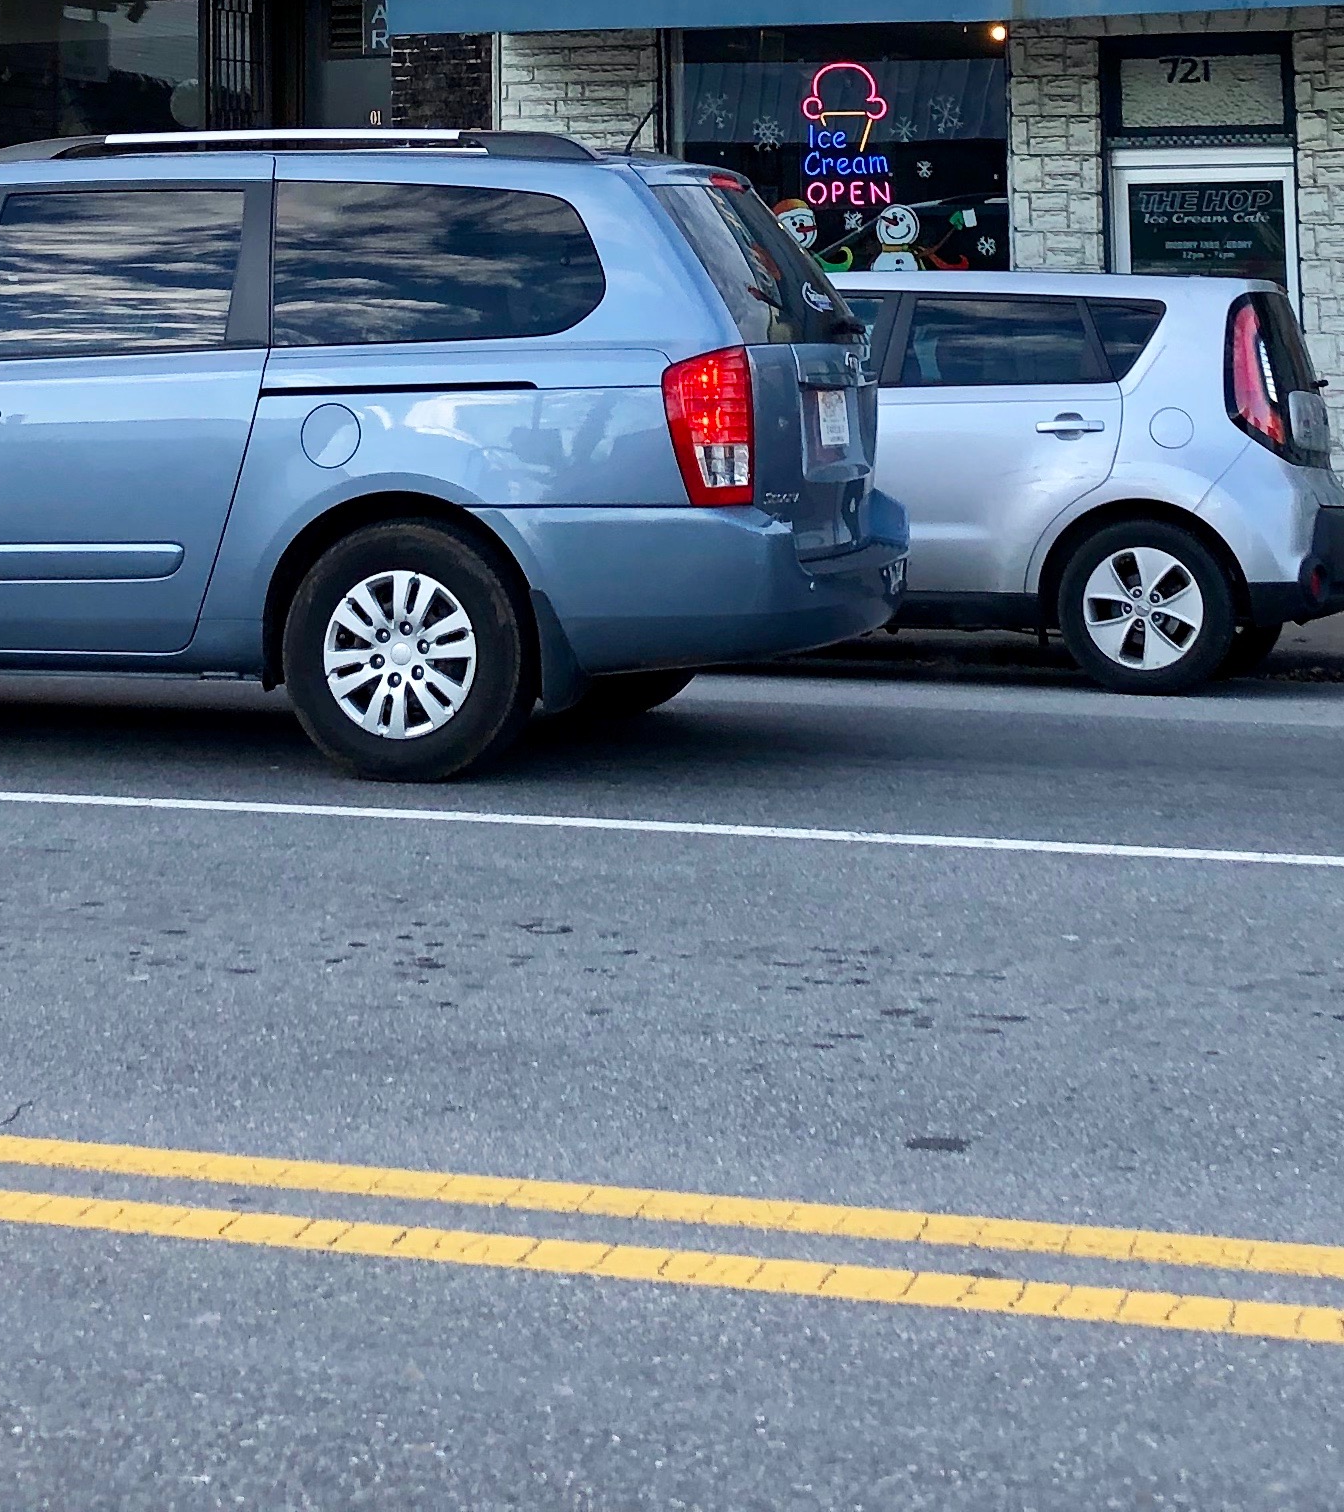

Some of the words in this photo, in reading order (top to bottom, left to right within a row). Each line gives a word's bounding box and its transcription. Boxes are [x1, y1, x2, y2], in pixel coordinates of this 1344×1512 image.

[1158, 57, 1211, 84] 721
[809, 123, 847, 149] Ice
[804, 150, 889, 176] Cream
[807, 181, 891, 205] OPEN
[1139, 190, 1200, 213] THE
[1202, 189, 1274, 212] HOP
[1172, 213, 1229, 224] Cream
